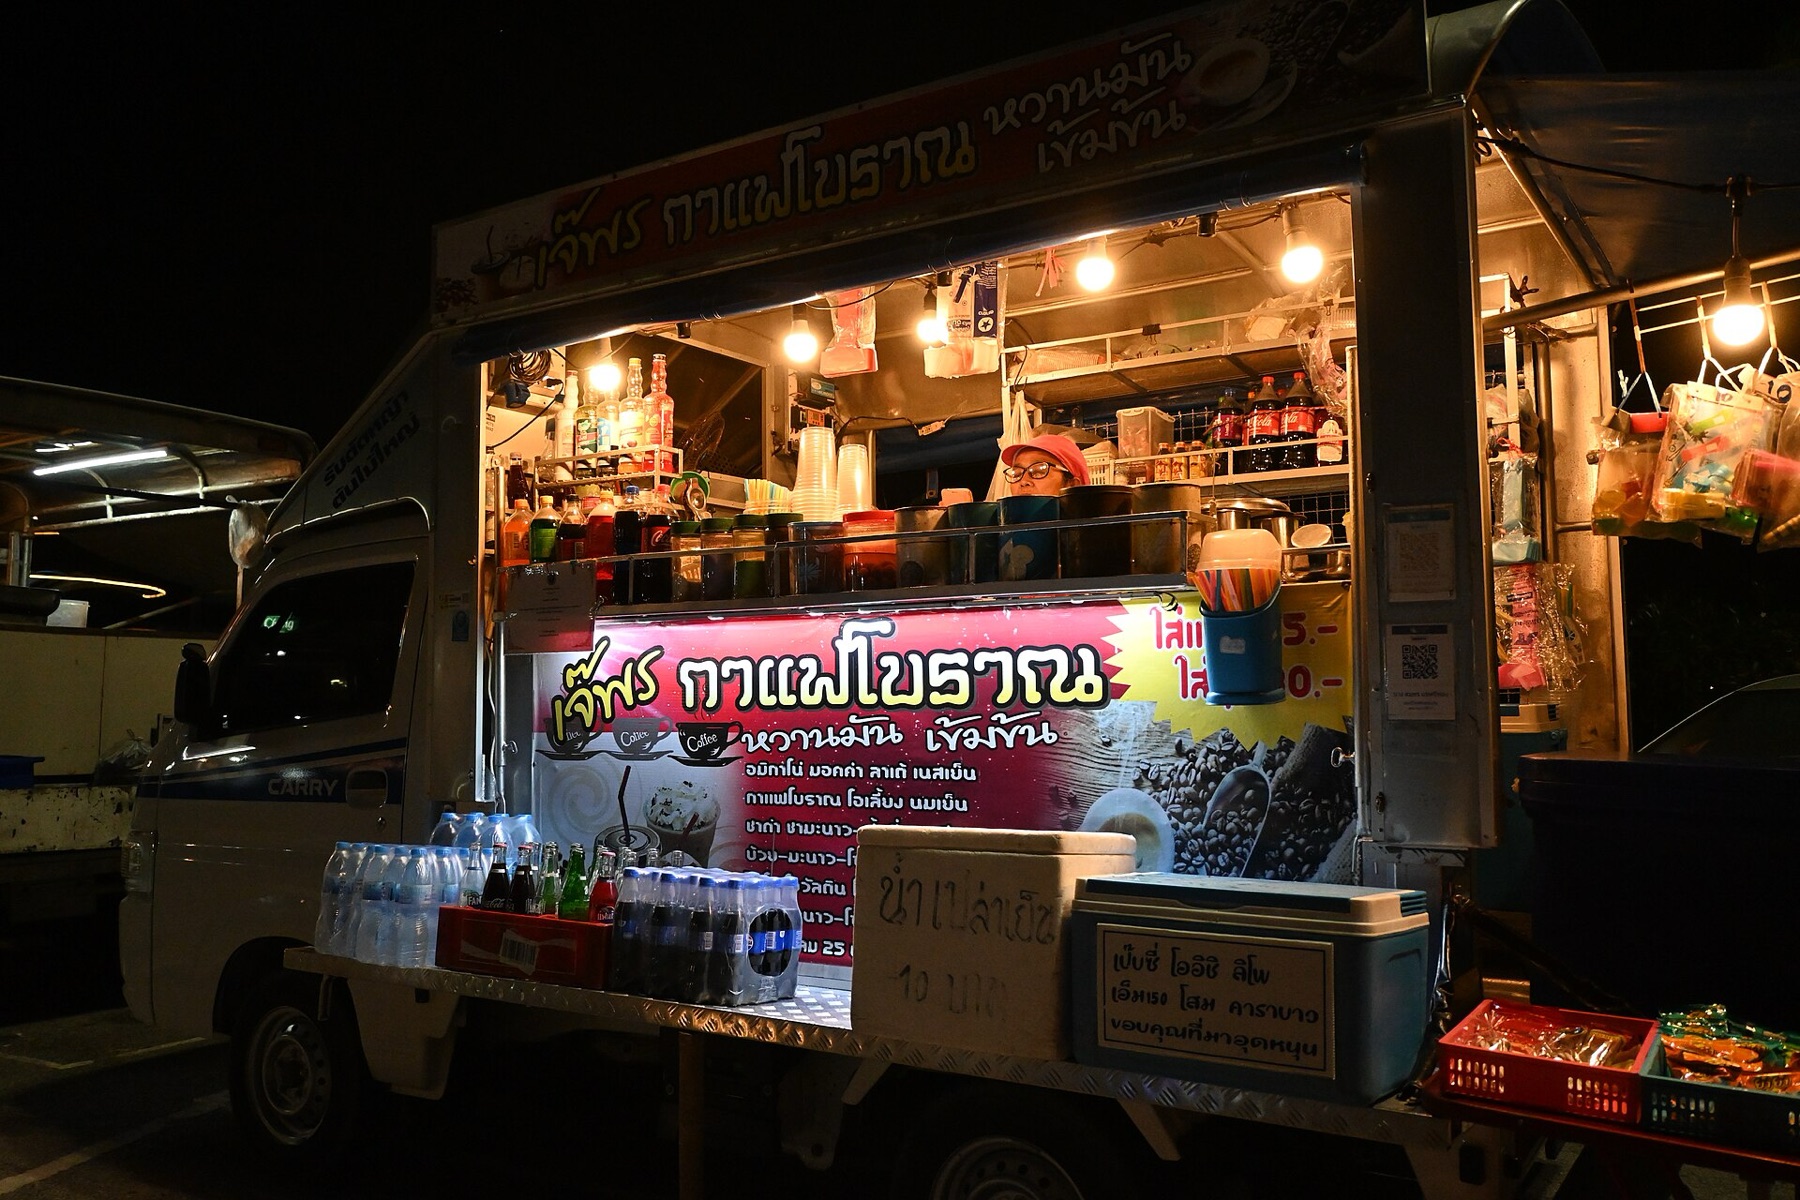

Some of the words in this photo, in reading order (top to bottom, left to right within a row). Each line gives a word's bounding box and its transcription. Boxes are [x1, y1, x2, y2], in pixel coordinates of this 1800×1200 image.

[983, 32, 1192, 136] หวานมัน
[1037, 85, 1188, 174] เข้มข้น
[534, 186, 654, 288] เจ๊พร
[661, 124, 978, 247] กาแฟโบราณ
[1768, 380, 1792, 403] 10
[1149, 604, 1204, 650] ใส่แ
[1282, 612, 1339, 646] 5.-
[553, 636, 666, 744] เจ๊พร
[676, 618, 1109, 712] กาแฟโบราณ
[1284, 664, 1343, 699] 0.-
[686, 733, 718, 752] Coffee
[741, 714, 903, 752] หวานมัน
[925, 711, 1057, 752] เข้มข้น
[267, 778, 339, 797] CARRY
[745, 757, 804, 777] อมิกาโน่
[809, 761, 864, 778] มอคค่า
[869, 762, 907, 779] ลาเต้
[913, 762, 977, 781] เนสเย็น
[745, 786, 842, 807] กาแฟโบราณ
[847, 787, 904, 809] โอเลี้ยง
[909, 793, 968, 812] นมเย็น
[745, 818, 781, 835] ชาดำ
[800, 877, 847, 896] วัลติน
[822, 940, 846, 957] 25
[1171, 947, 1219, 979] โออิชิ
[1232, 954, 1270, 985] ลิโพ
[899, 964, 929, 1002] 10
[1112, 980, 1168, 1006] เอ็ม150
[1180, 984, 1216, 1011] โสม
[1229, 1001, 1319, 1024] คาราบาว
[1111, 1017, 1318, 1061] ขอบคุณที่มาอุดหนุน
